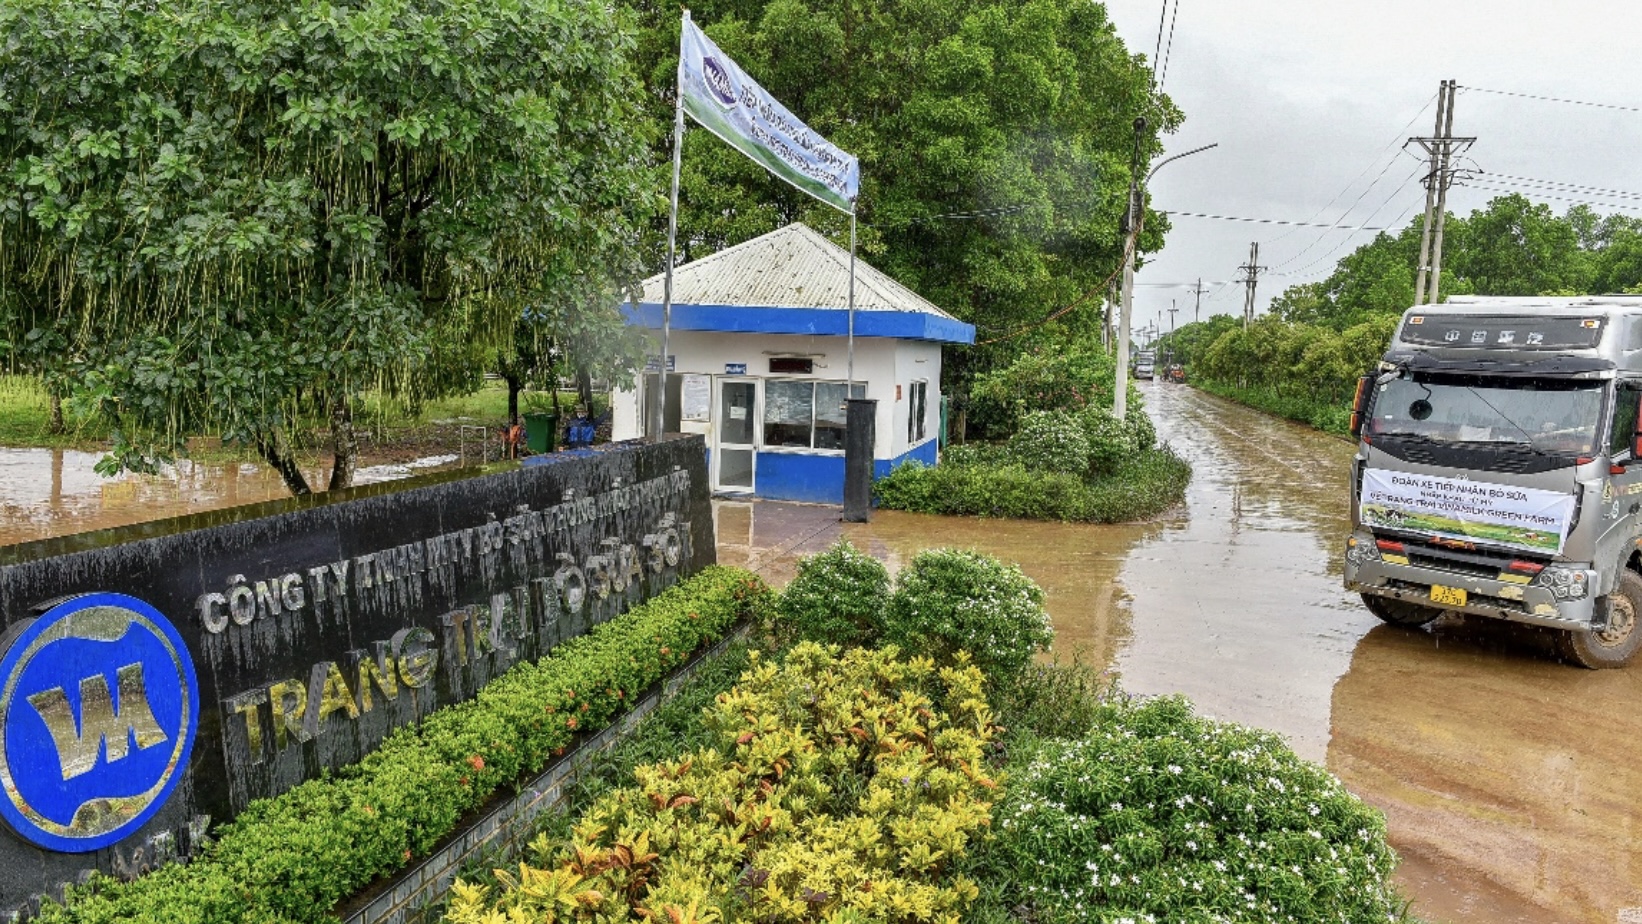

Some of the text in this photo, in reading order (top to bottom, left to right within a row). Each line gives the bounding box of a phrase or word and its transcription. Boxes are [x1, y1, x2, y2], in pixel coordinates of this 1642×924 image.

[1392, 476, 1419, 487] ĐOÀN
[1420, 480, 1433, 489] XE
[1487, 509, 1522, 521] GREEN
[1523, 514, 1555, 525] FARM
[197, 573, 305, 634] CÔNG
[307, 559, 350, 602] TY
[221, 626, 438, 765] TRANG
